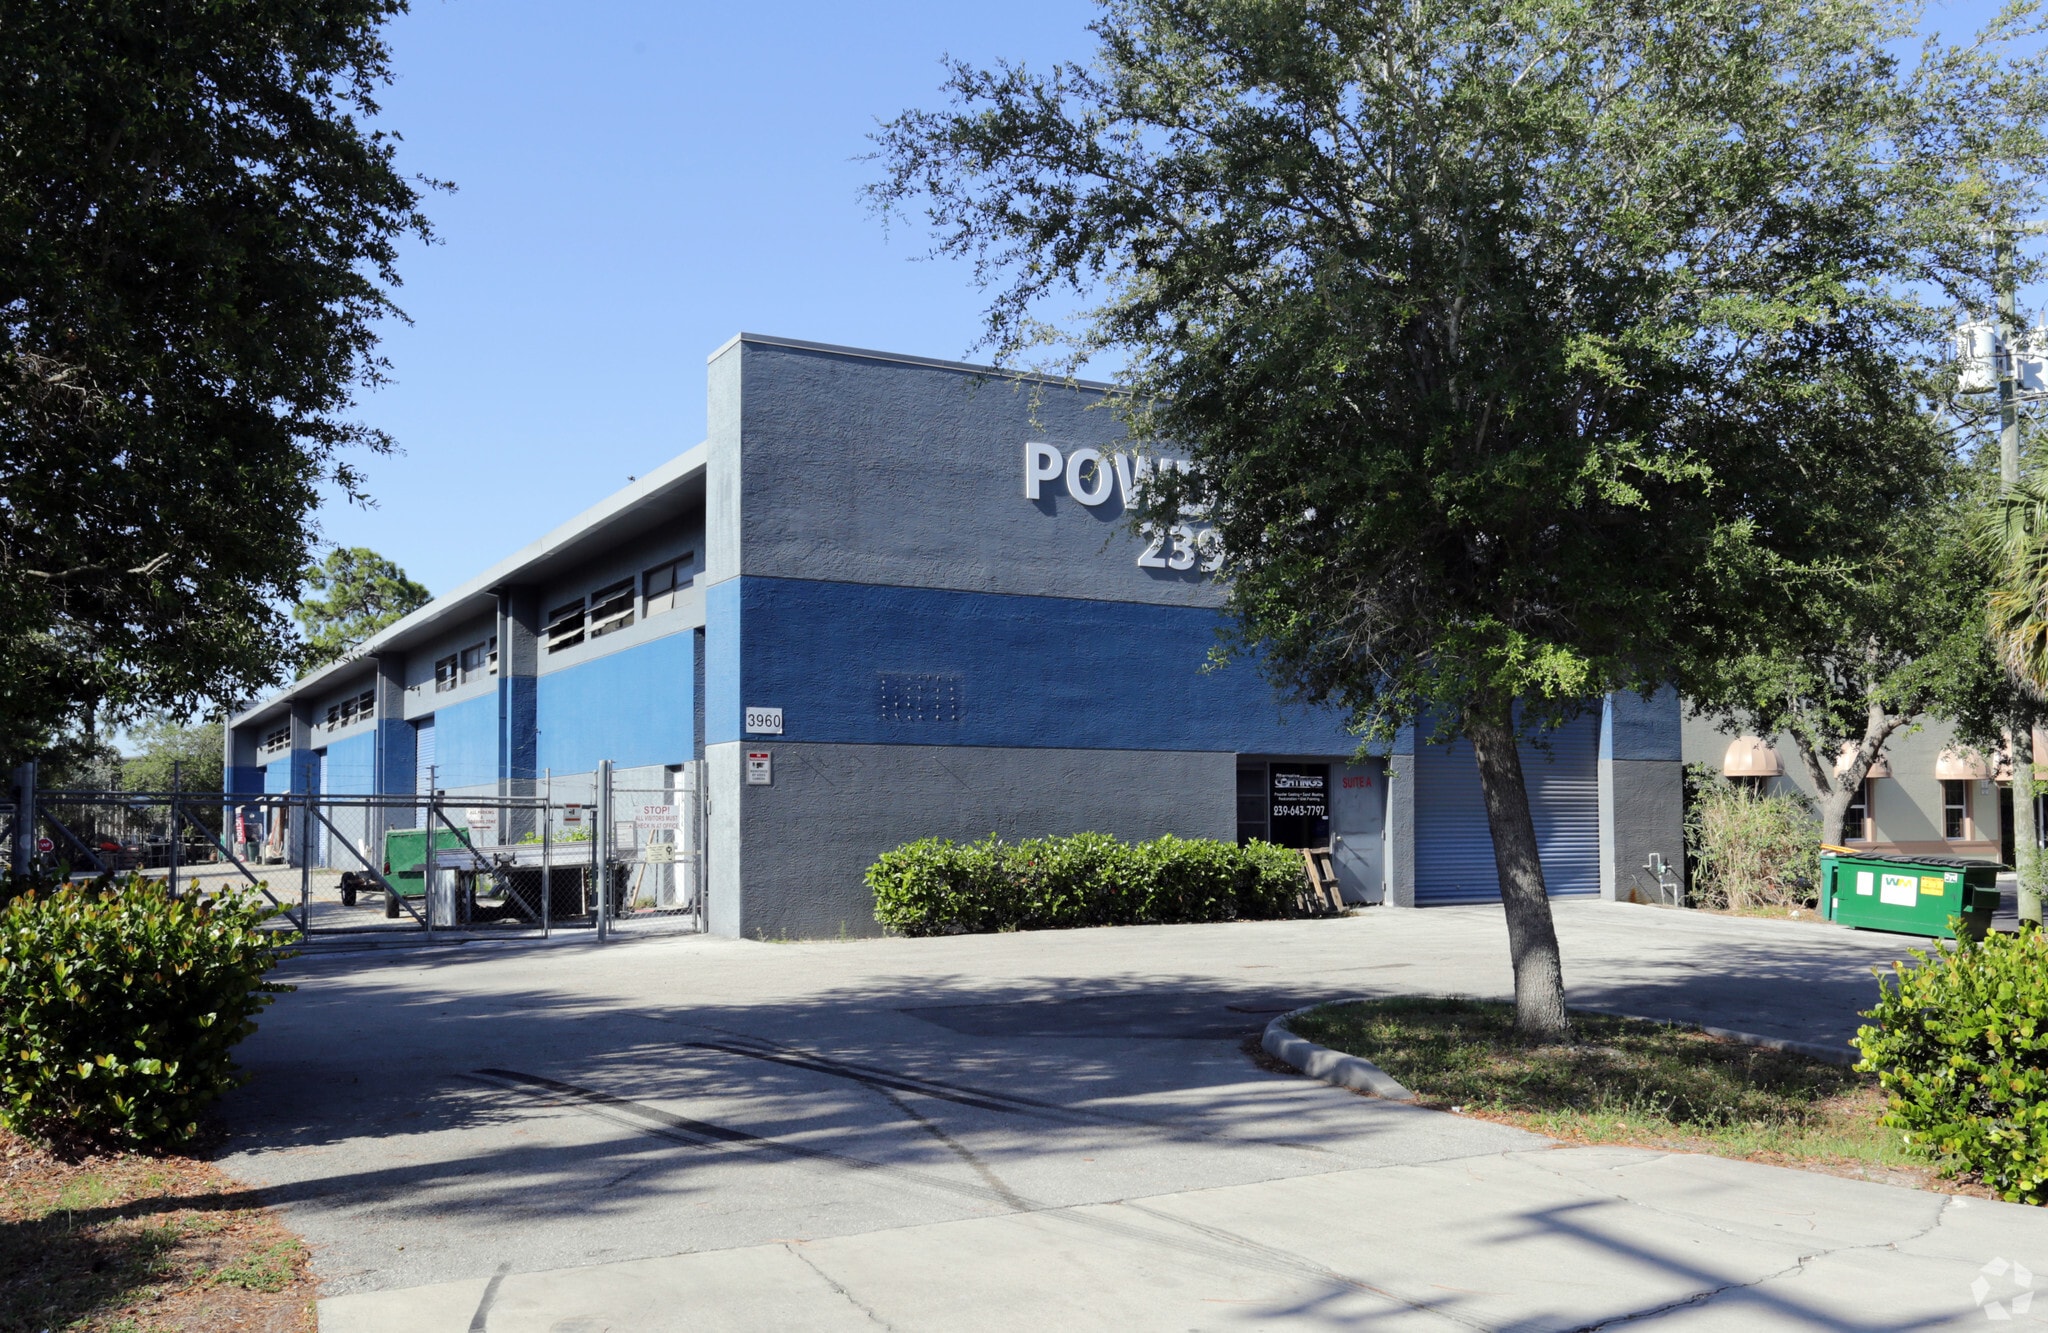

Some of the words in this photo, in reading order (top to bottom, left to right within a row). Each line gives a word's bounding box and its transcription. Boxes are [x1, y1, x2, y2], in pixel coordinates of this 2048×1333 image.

[748, 713, 781, 727] 3960
[1274, 777, 1323, 787] COATINGS
[1342, 776, 1364, 788] SUITE
[1366, 776, 1372, 788] A
[643, 805, 671, 815] STOP!
[1273, 805, 1325, 816] 239-643-7797
